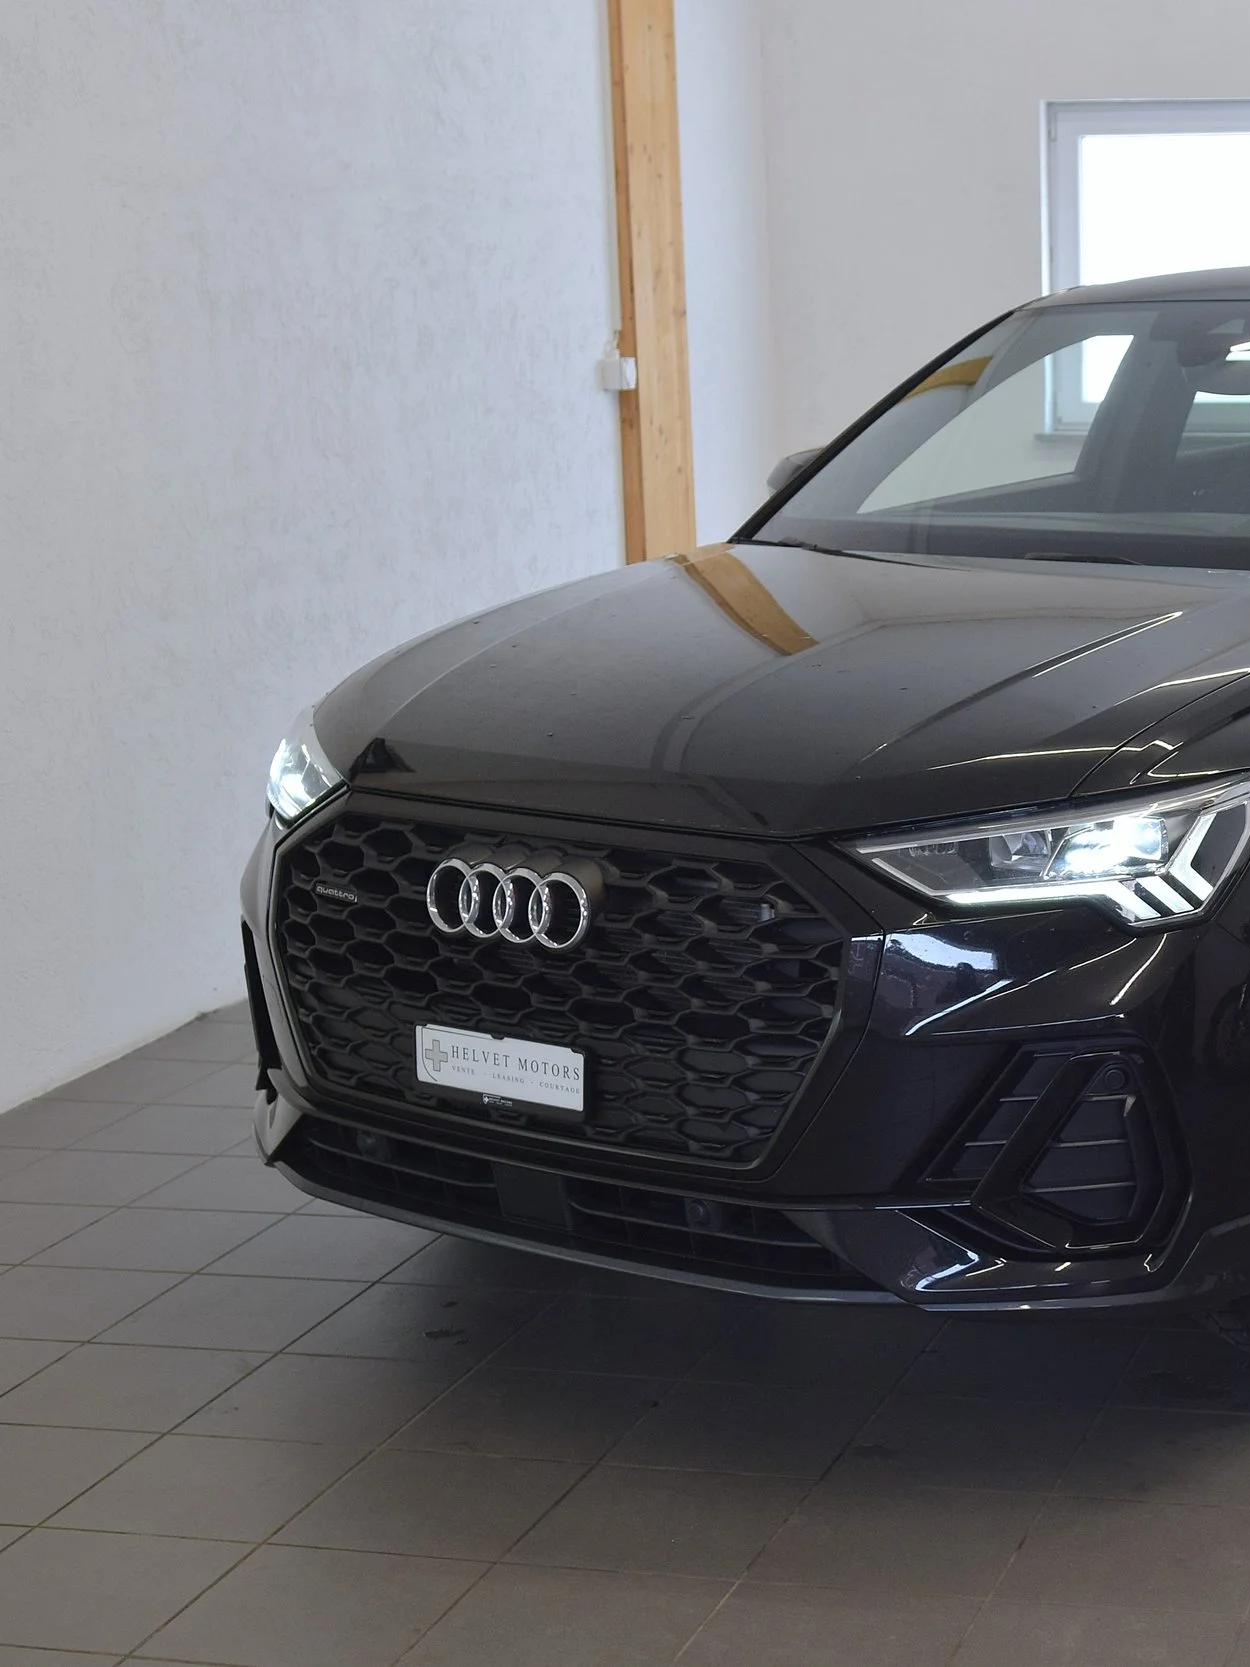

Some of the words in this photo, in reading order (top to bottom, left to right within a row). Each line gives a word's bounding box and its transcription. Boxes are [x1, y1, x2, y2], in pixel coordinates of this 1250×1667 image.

[316, 886, 354, 900] quattro
[451, 1045, 510, 1068] HELVET
[518, 1057, 580, 1081] MOTORS
[452, 1065, 475, 1076] VENTE
[492, 1073, 525, 1084] LEASING
[540, 1081, 580, 1094] COURTAGE
